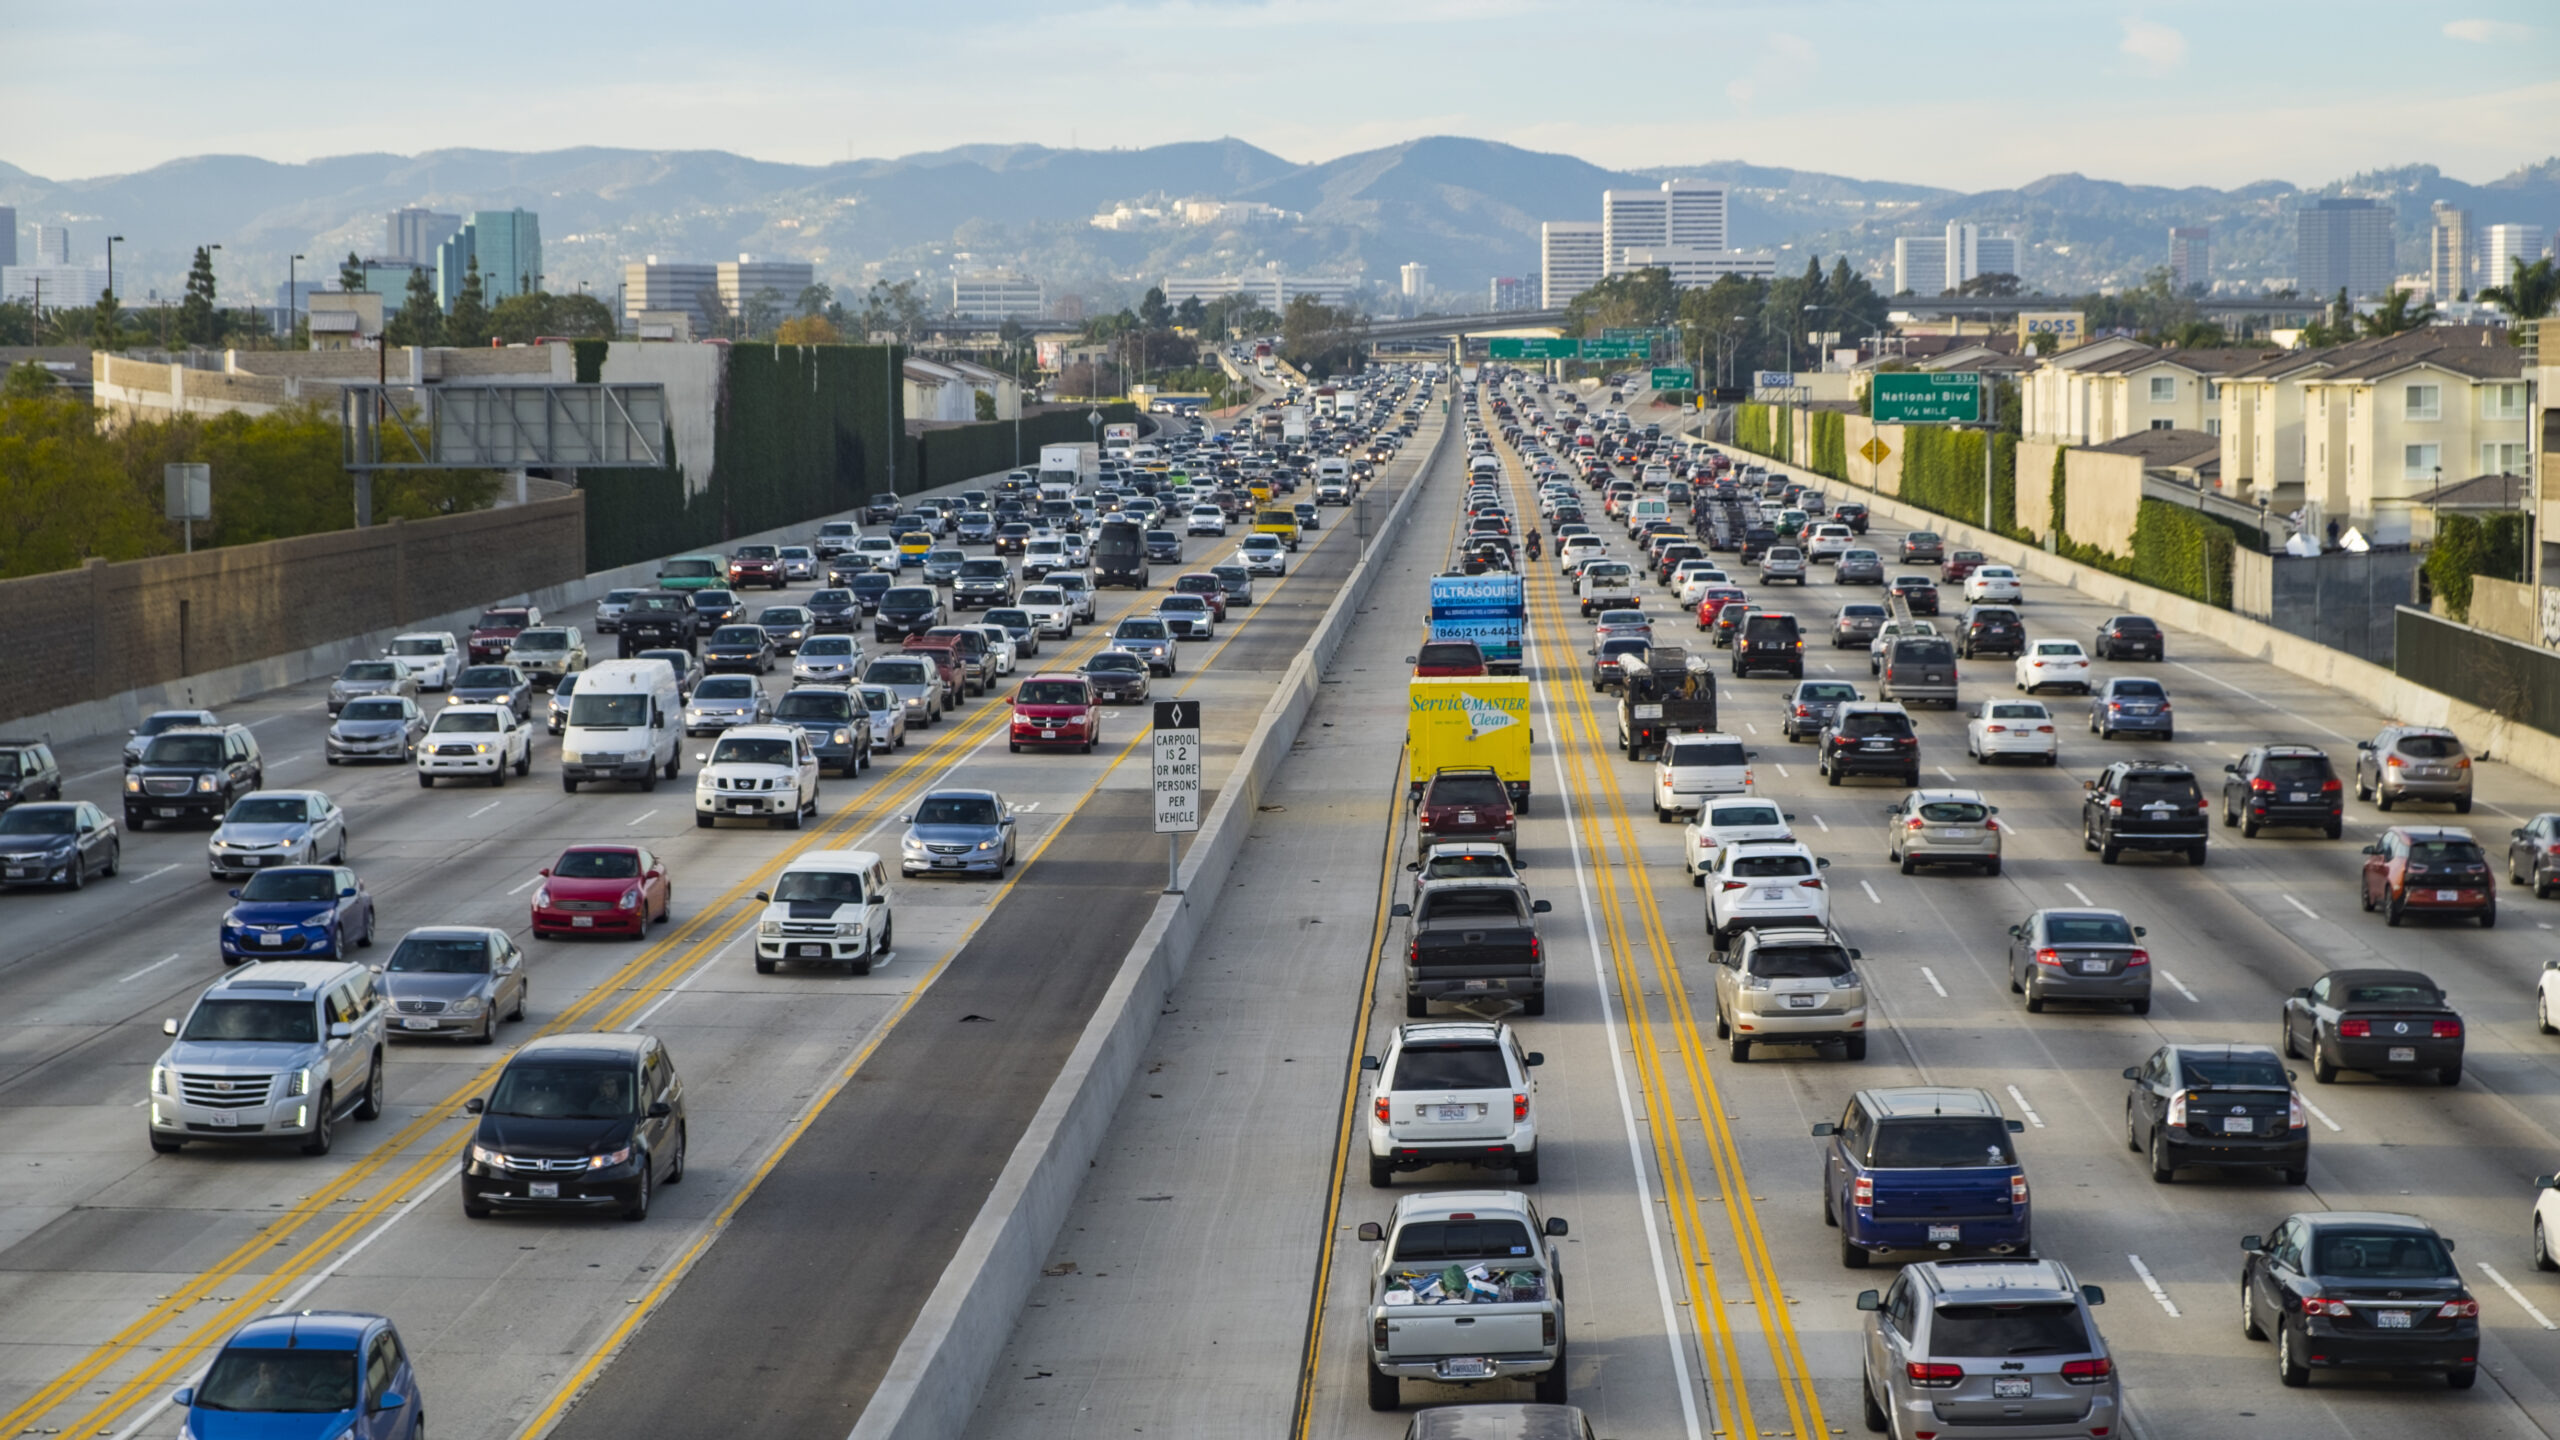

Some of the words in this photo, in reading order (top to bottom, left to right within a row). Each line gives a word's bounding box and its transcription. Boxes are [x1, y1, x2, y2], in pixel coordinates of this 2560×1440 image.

[2028, 319, 2076, 333] ROSS
[1763, 374, 1793, 385] ROSS
[1881, 391, 1937, 402] National
[1941, 391, 1971, 402] Blvd
[1922, 406, 1948, 415] MILE
[1106, 429, 1130, 438] FedEx
[1433, 585, 1519, 599] ULTRASOUND
[1435, 626, 1519, 639] (866)216-4443
[1471, 712, 1509, 727] Clean
[1156, 734, 1198, 746] CARPOOL
[1166, 749, 1175, 760] IS
[1178, 747, 1187, 761] 2
[1156, 765, 1169, 776] OR
[1172, 763, 1197, 775] MORE
[1156, 780, 1198, 792] PERSONS
[1168, 795, 1185, 807] PER
[1158, 811, 1195, 824] VEHICLE
[2000, 1361, 2024, 1371] Jeep
